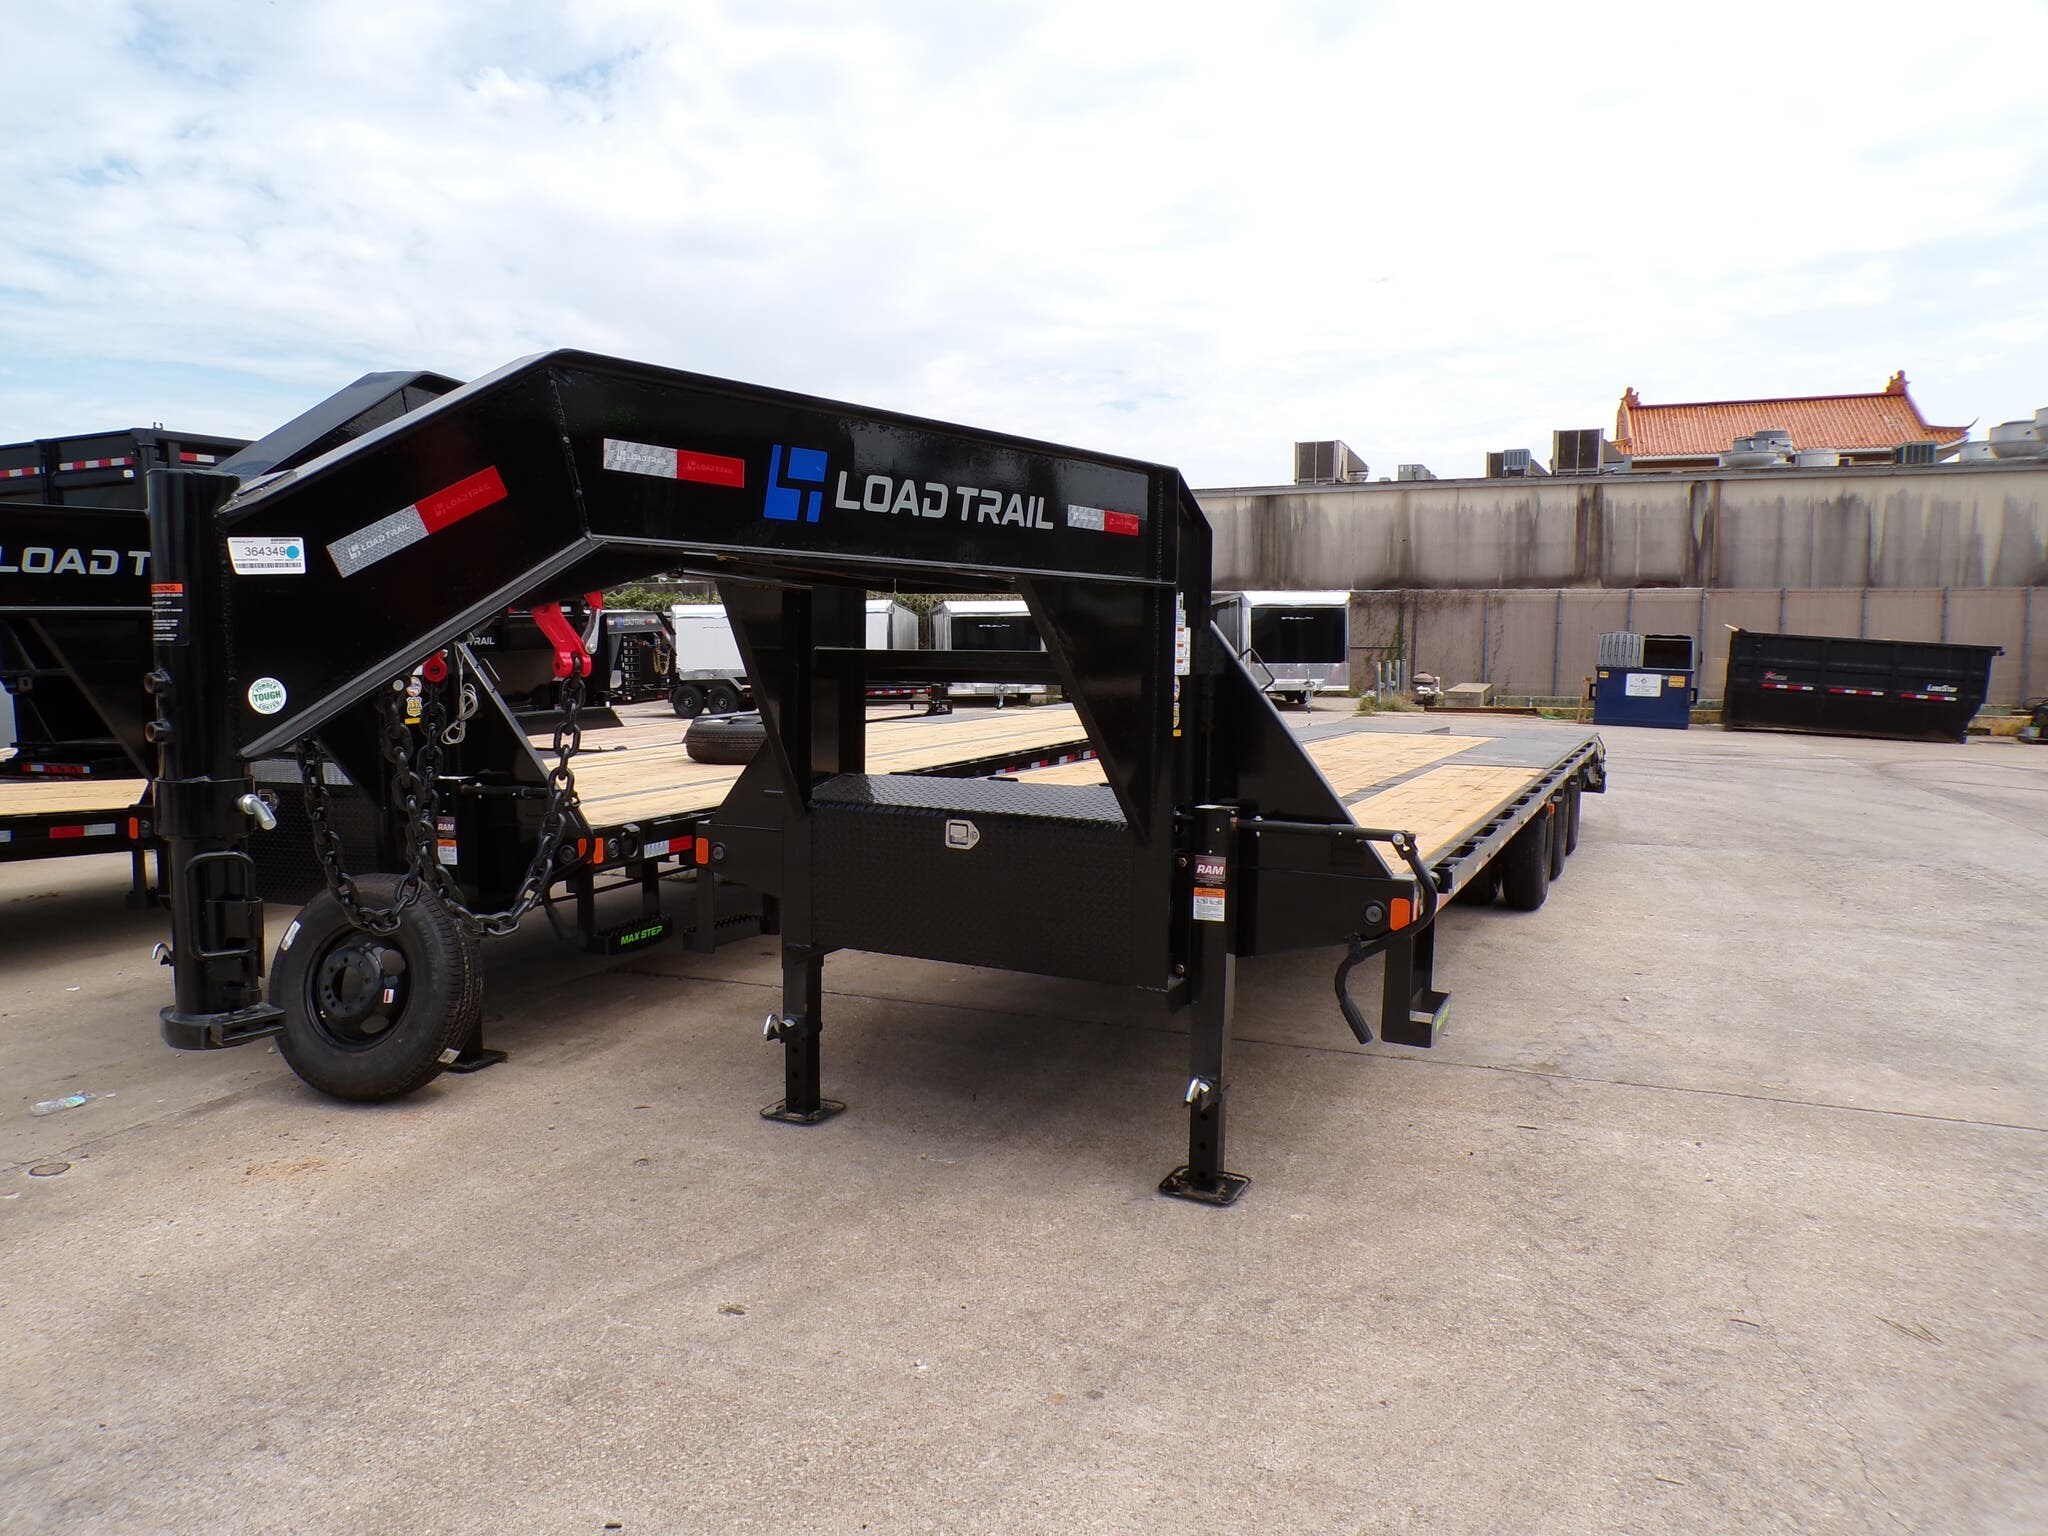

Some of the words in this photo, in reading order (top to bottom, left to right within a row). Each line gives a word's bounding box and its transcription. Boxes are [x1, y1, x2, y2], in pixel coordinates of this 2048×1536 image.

[445, 493, 468, 509] LOAD
[467, 482, 491, 498] TRAIL
[835, 471, 949, 519] LOAD
[956, 486, 1054, 530] TRAIL
[361, 534, 385, 551] LOAD
[385, 523, 410, 539] TRAIL
[0, 546, 119, 575] LOAD
[244, 546, 286, 556] 364349
[253, 691, 281, 702] TOUGH
[438, 823, 454, 831] RAM
[1196, 864, 1224, 876] RAM
[621, 932, 640, 945] MAX
[641, 925, 662, 939] STEP
